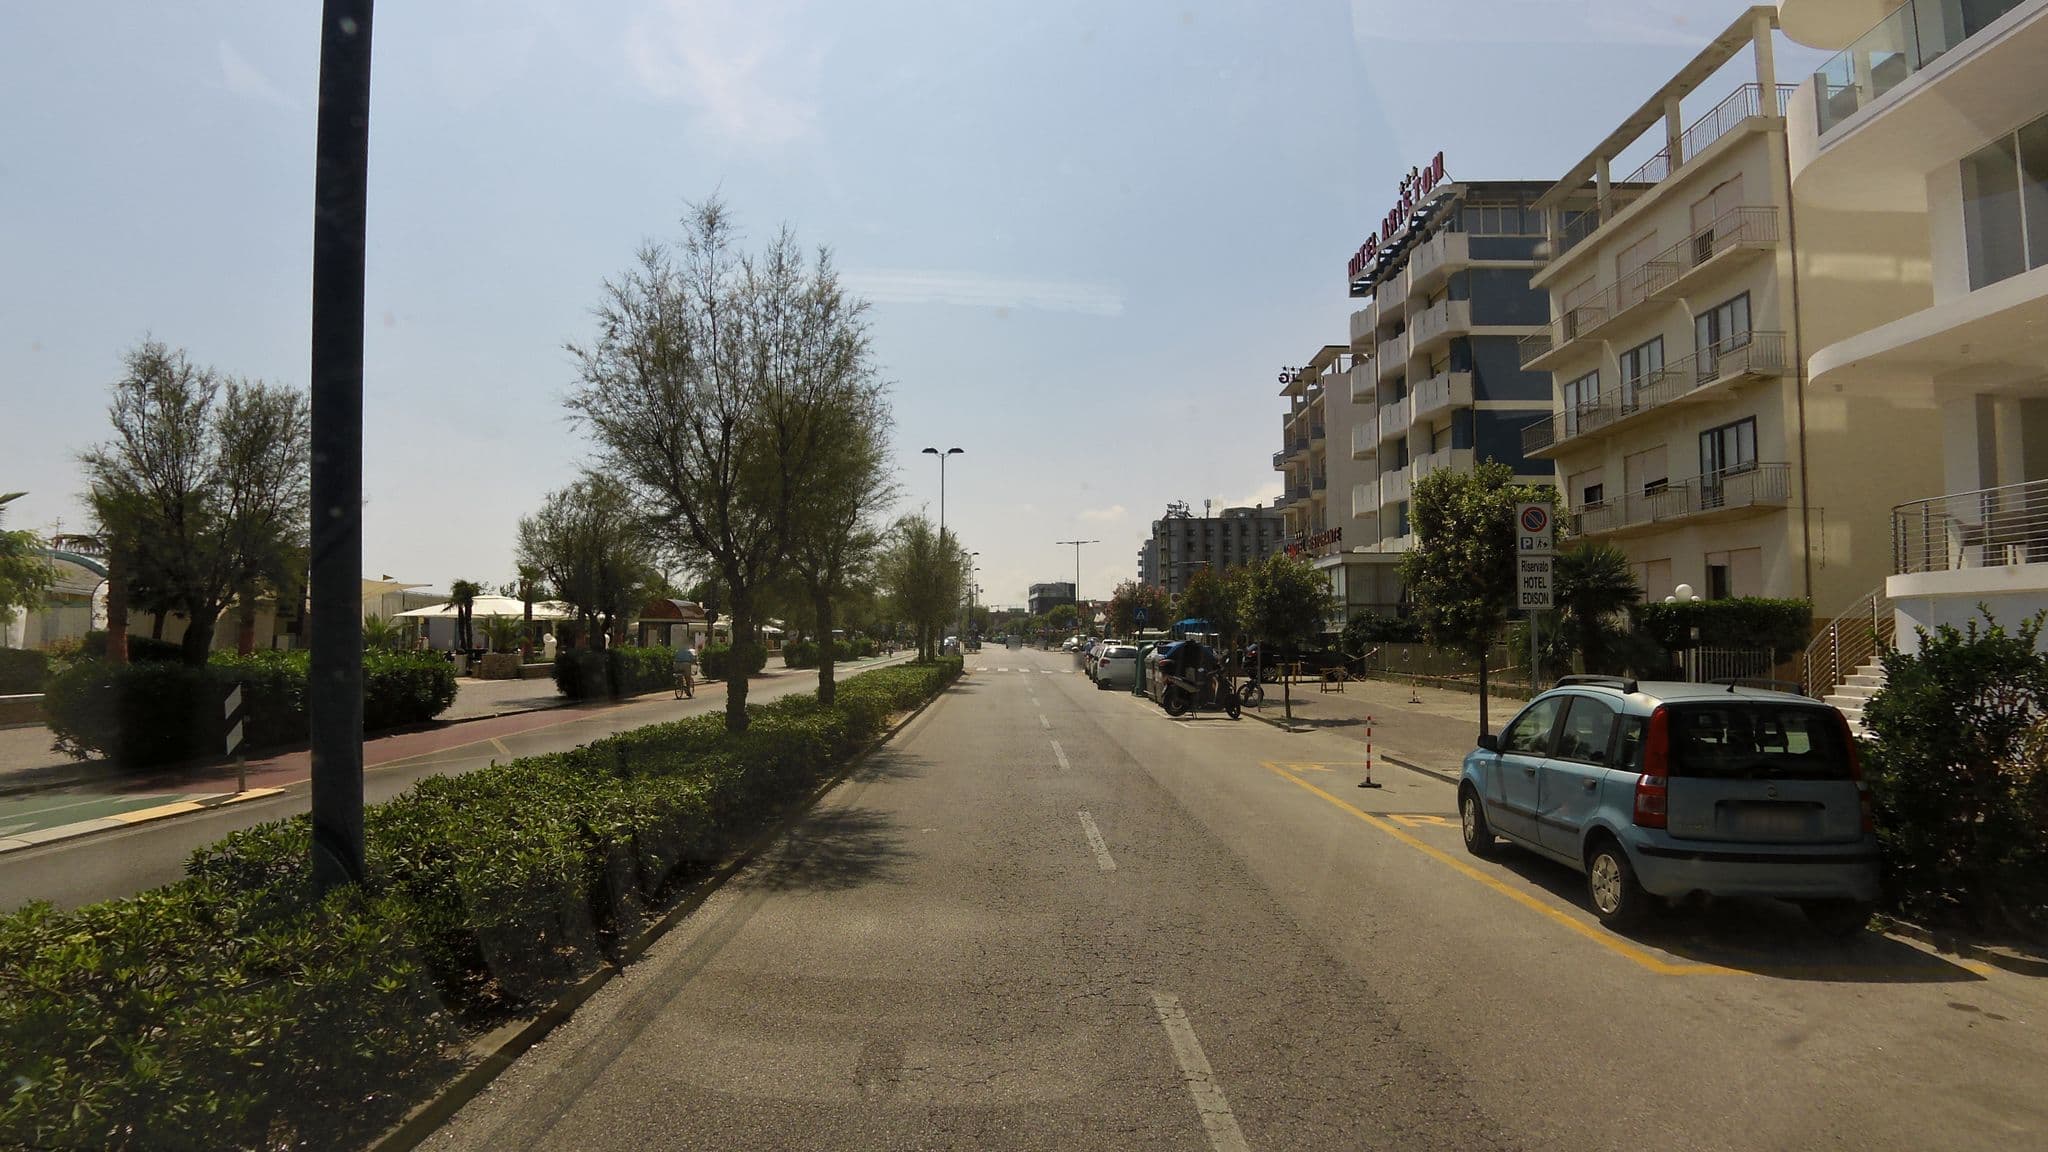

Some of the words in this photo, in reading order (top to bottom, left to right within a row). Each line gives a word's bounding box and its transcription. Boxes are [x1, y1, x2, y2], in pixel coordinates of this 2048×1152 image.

[1348, 232, 1377, 277] HOTEL
[1381, 151, 1443, 241] ARISTON
[1521, 560, 1549, 573] Riservato
[1523, 577, 1547, 589] HOTEL
[1522, 592, 1549, 605] EDISON
